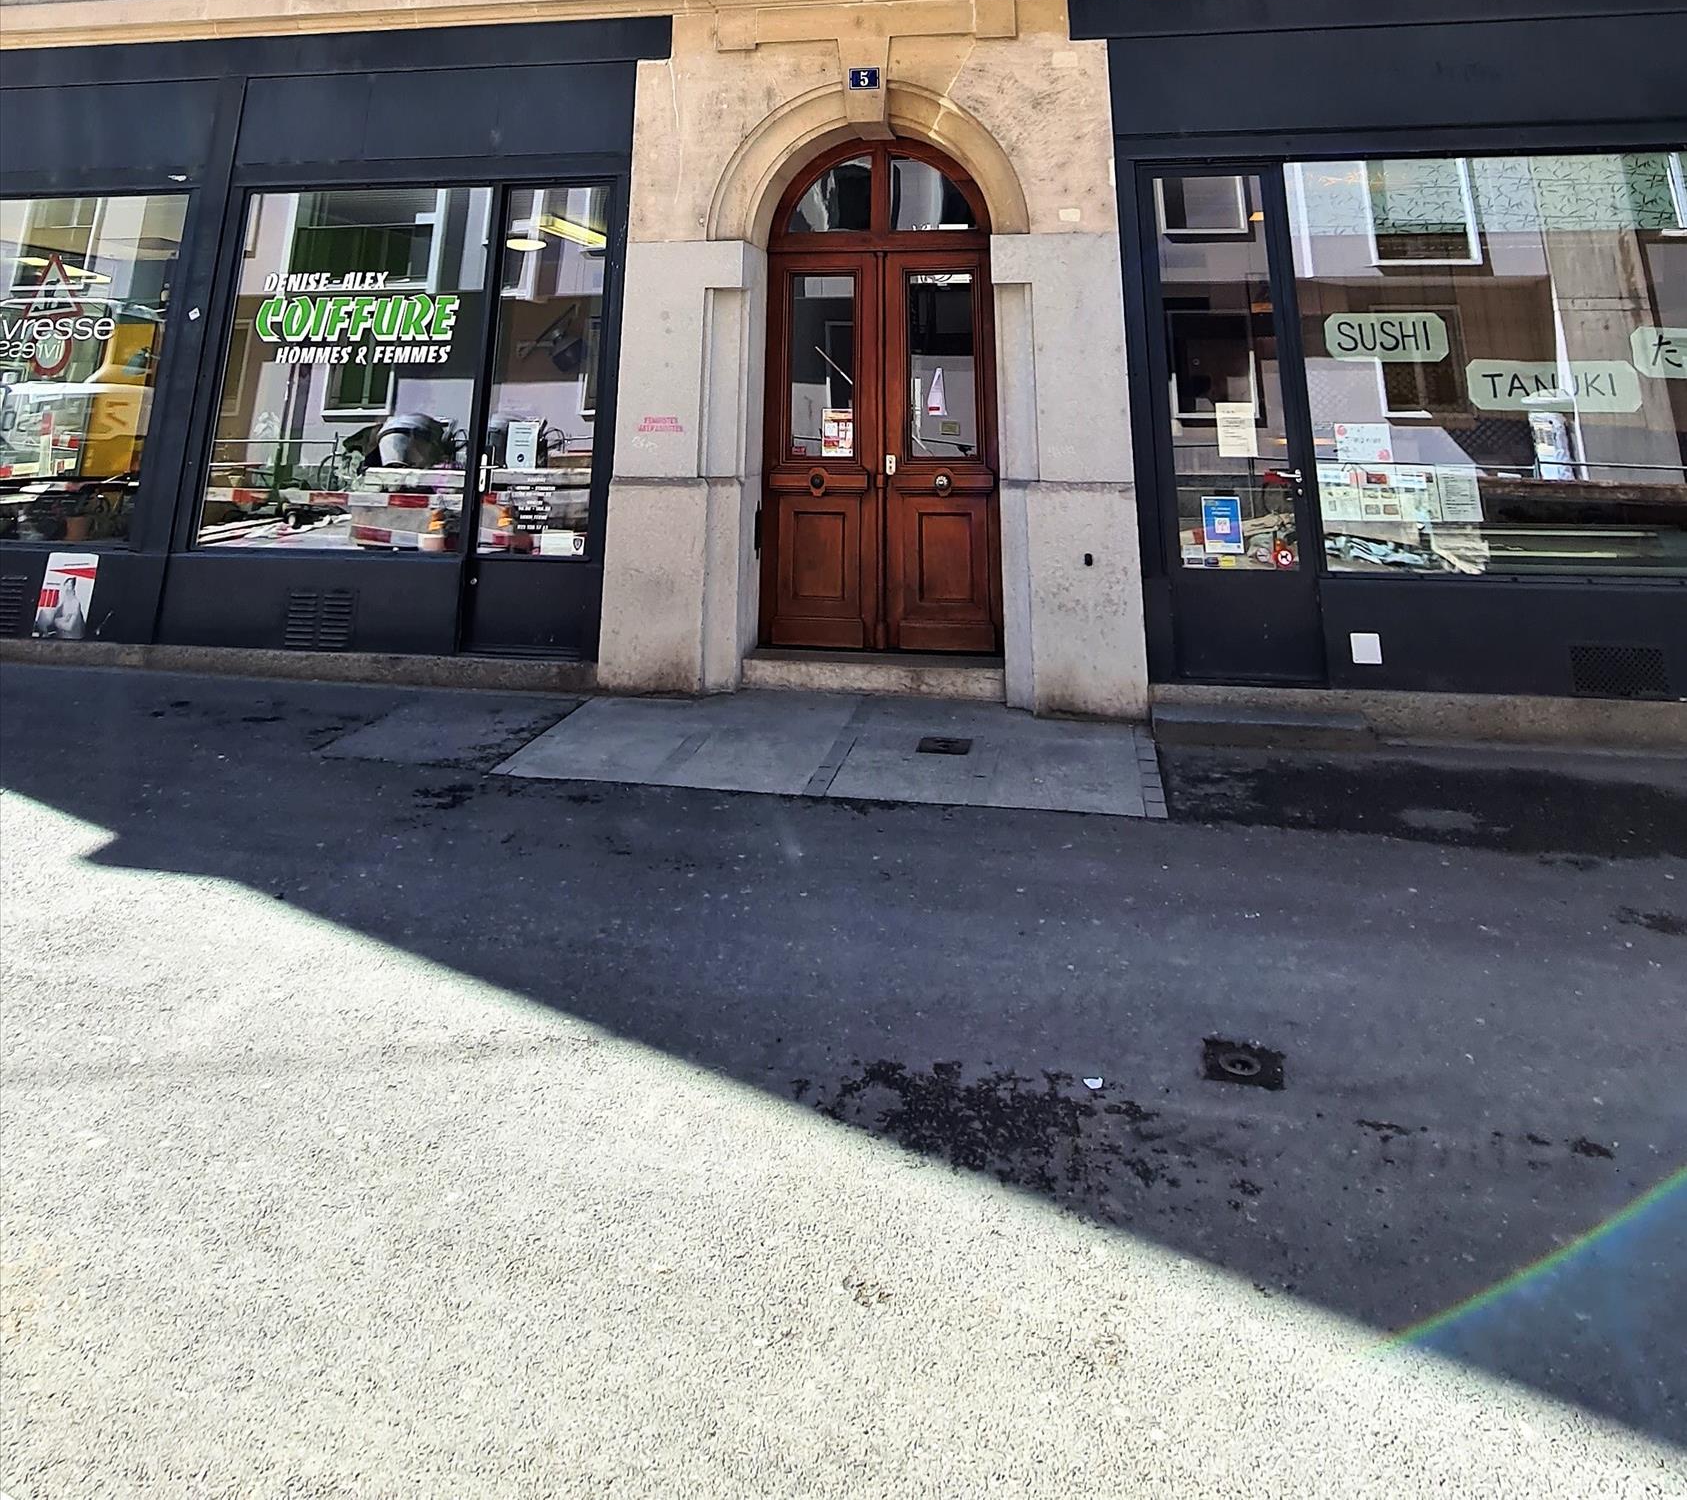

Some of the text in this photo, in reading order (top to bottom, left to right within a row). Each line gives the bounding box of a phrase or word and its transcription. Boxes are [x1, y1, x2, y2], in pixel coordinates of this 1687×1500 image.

[860, 71, 869, 86] 5
[255, 294, 460, 342] COIFFURE
[1337, 321, 1431, 351] SUSHI
[1652, 335, 1683, 367] た
[275, 344, 450, 365] HOMMES & FEMMES
